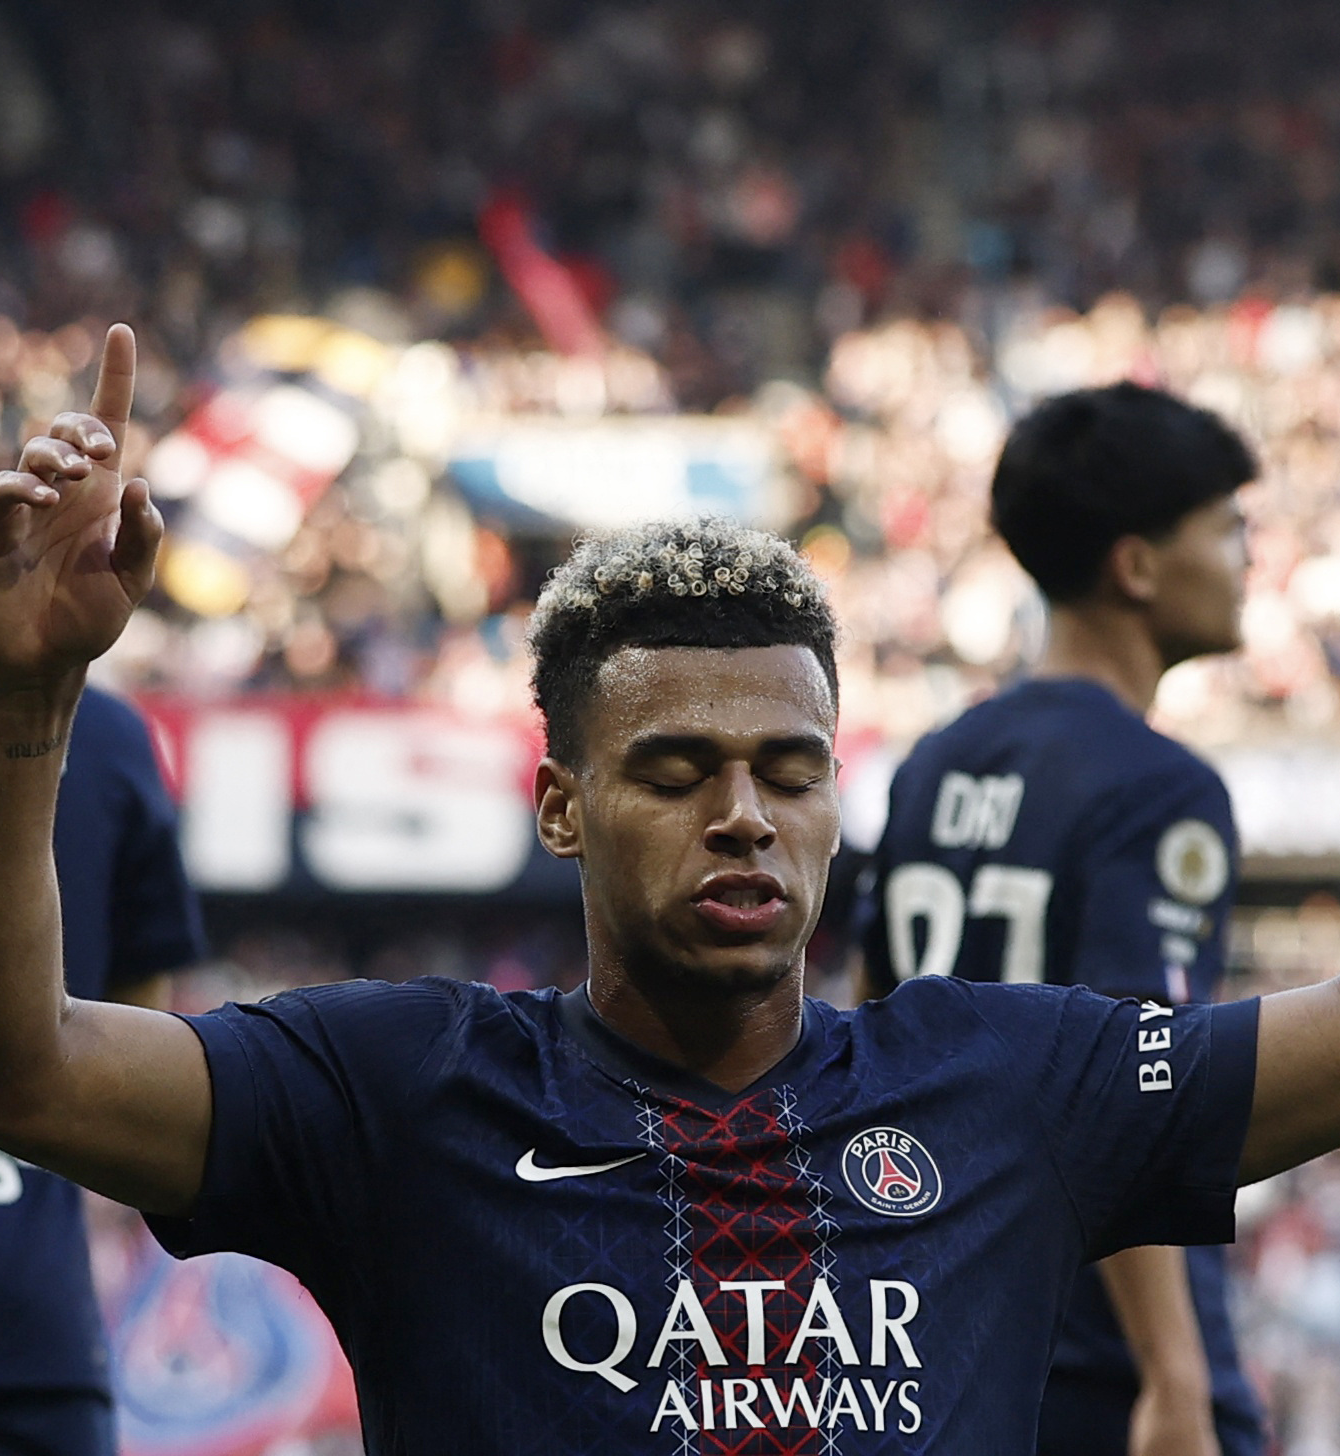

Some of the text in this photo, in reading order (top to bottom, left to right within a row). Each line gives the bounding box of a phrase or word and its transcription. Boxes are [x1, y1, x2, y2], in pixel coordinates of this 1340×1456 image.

[850, 1131, 912, 1159] PARIS
[870, 1196, 897, 1210] SAINT
[541, 1278, 923, 1393] QATAR
[650, 1377, 923, 1434] AIRWAYS
